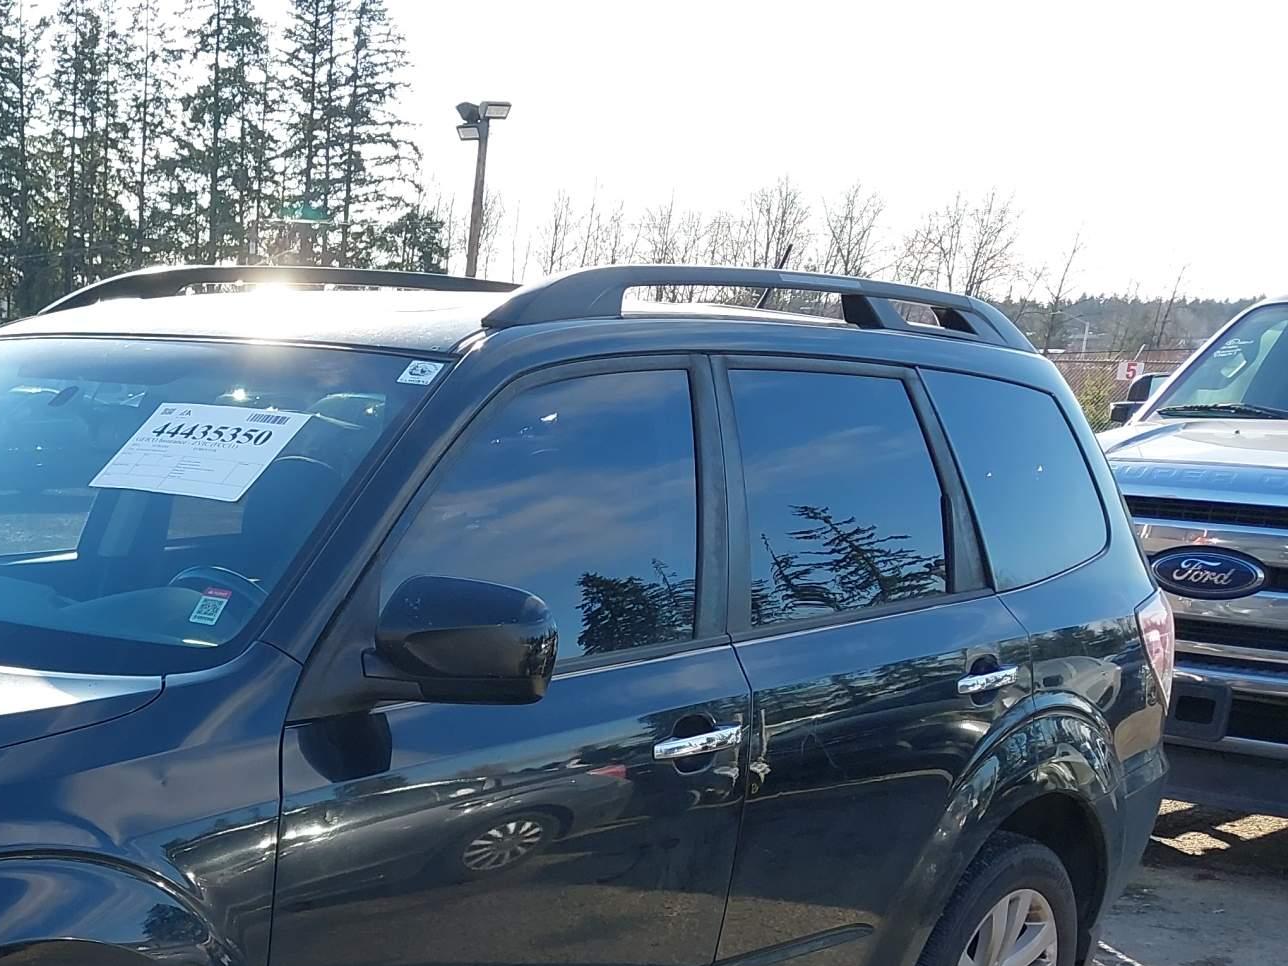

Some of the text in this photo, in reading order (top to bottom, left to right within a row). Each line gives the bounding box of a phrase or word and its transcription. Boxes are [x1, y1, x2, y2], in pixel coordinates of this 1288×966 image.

[1126, 362, 1137, 379] 5
[152, 422, 273, 446] 44435350
[1173, 558, 1236, 584] Ford
